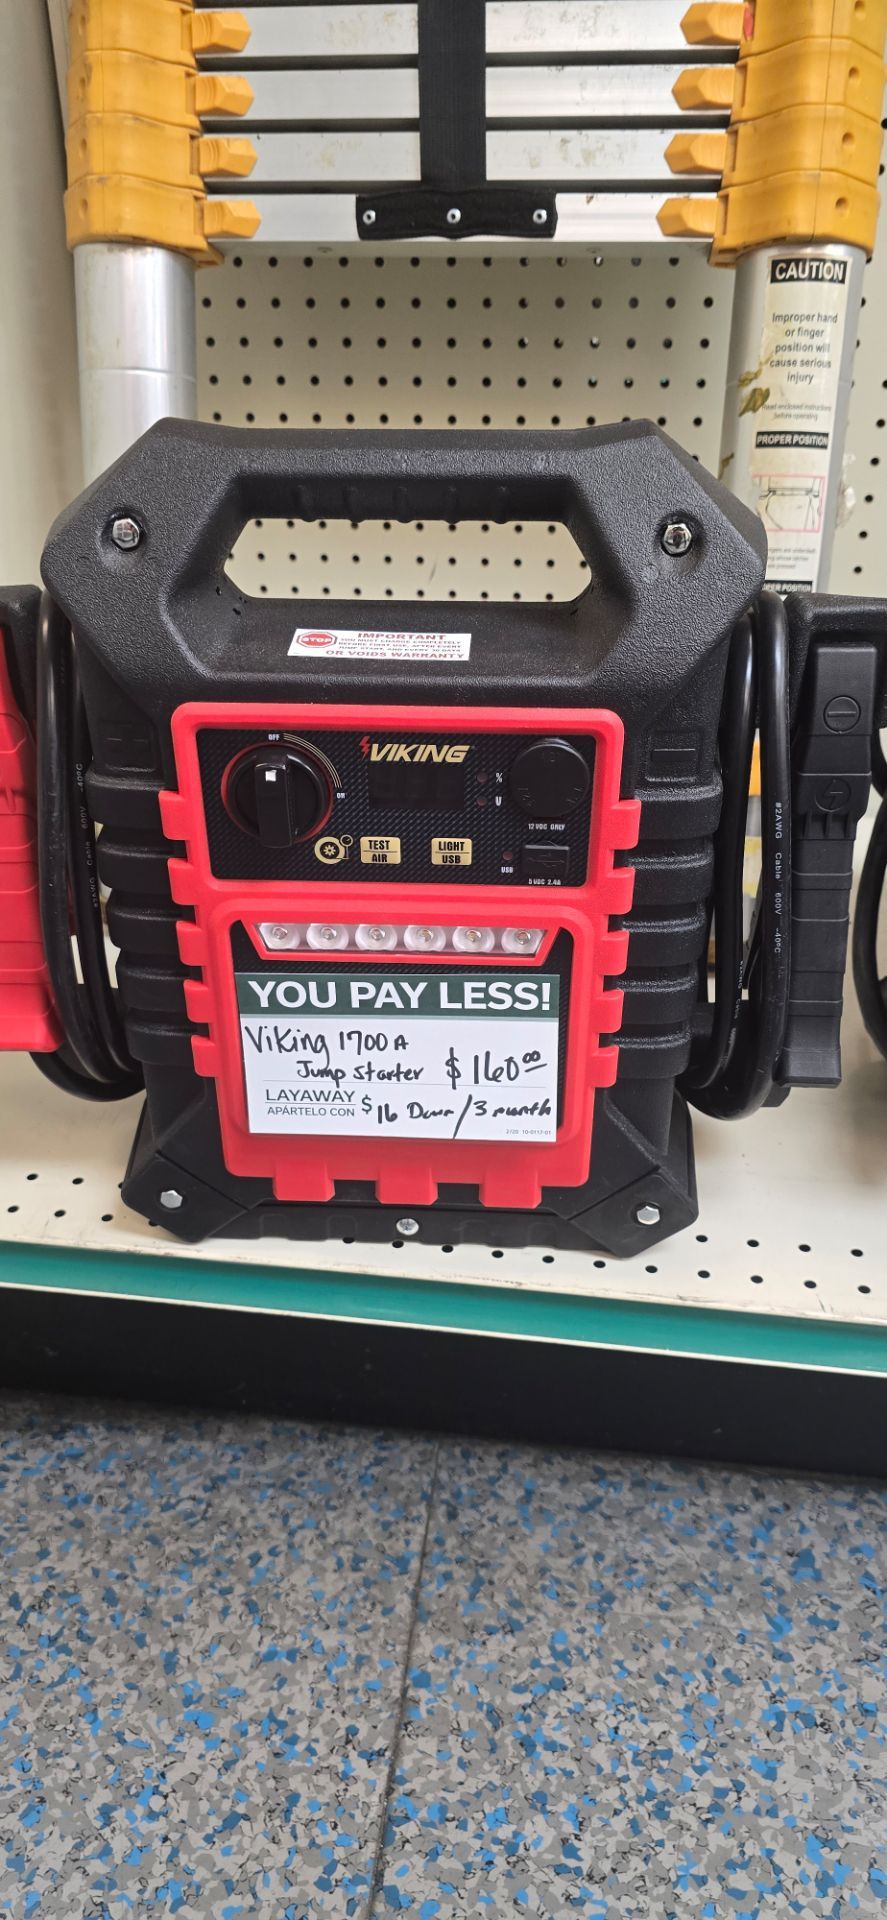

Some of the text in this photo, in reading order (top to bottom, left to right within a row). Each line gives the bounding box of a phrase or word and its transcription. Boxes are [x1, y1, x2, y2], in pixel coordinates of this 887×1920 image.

[775, 261, 844, 280] CAUTION
[772, 313, 838, 324] Improper hand
[785, 327, 824, 339] or finger
[775, 343, 830, 354] position will
[769, 359, 831, 368] cause serious
[787, 372, 814, 385] injury
[757, 434, 827, 445] PROPER POSITION
[370, 743, 470, 763] VIKING
[496, 773, 503, 783] %
[775, 802, 783, 839] #2AWG
[368, 840, 390, 850] TEST
[438, 842, 465, 851] LIGHT
[372, 854, 387, 863] AIR
[442, 855, 461, 864] USB
[248, 980, 550, 1011] YOU PAY LESS!
[245, 1025, 409, 1070] Viking 1700 A
[296, 1060, 346, 1088] Jump
[266, 1089, 355, 1103] LAYAWAY
[267, 1104, 355, 1117] APÁRTELO CON
[361, 1094, 372, 1115] $
[378, 1103, 398, 1124] 16
